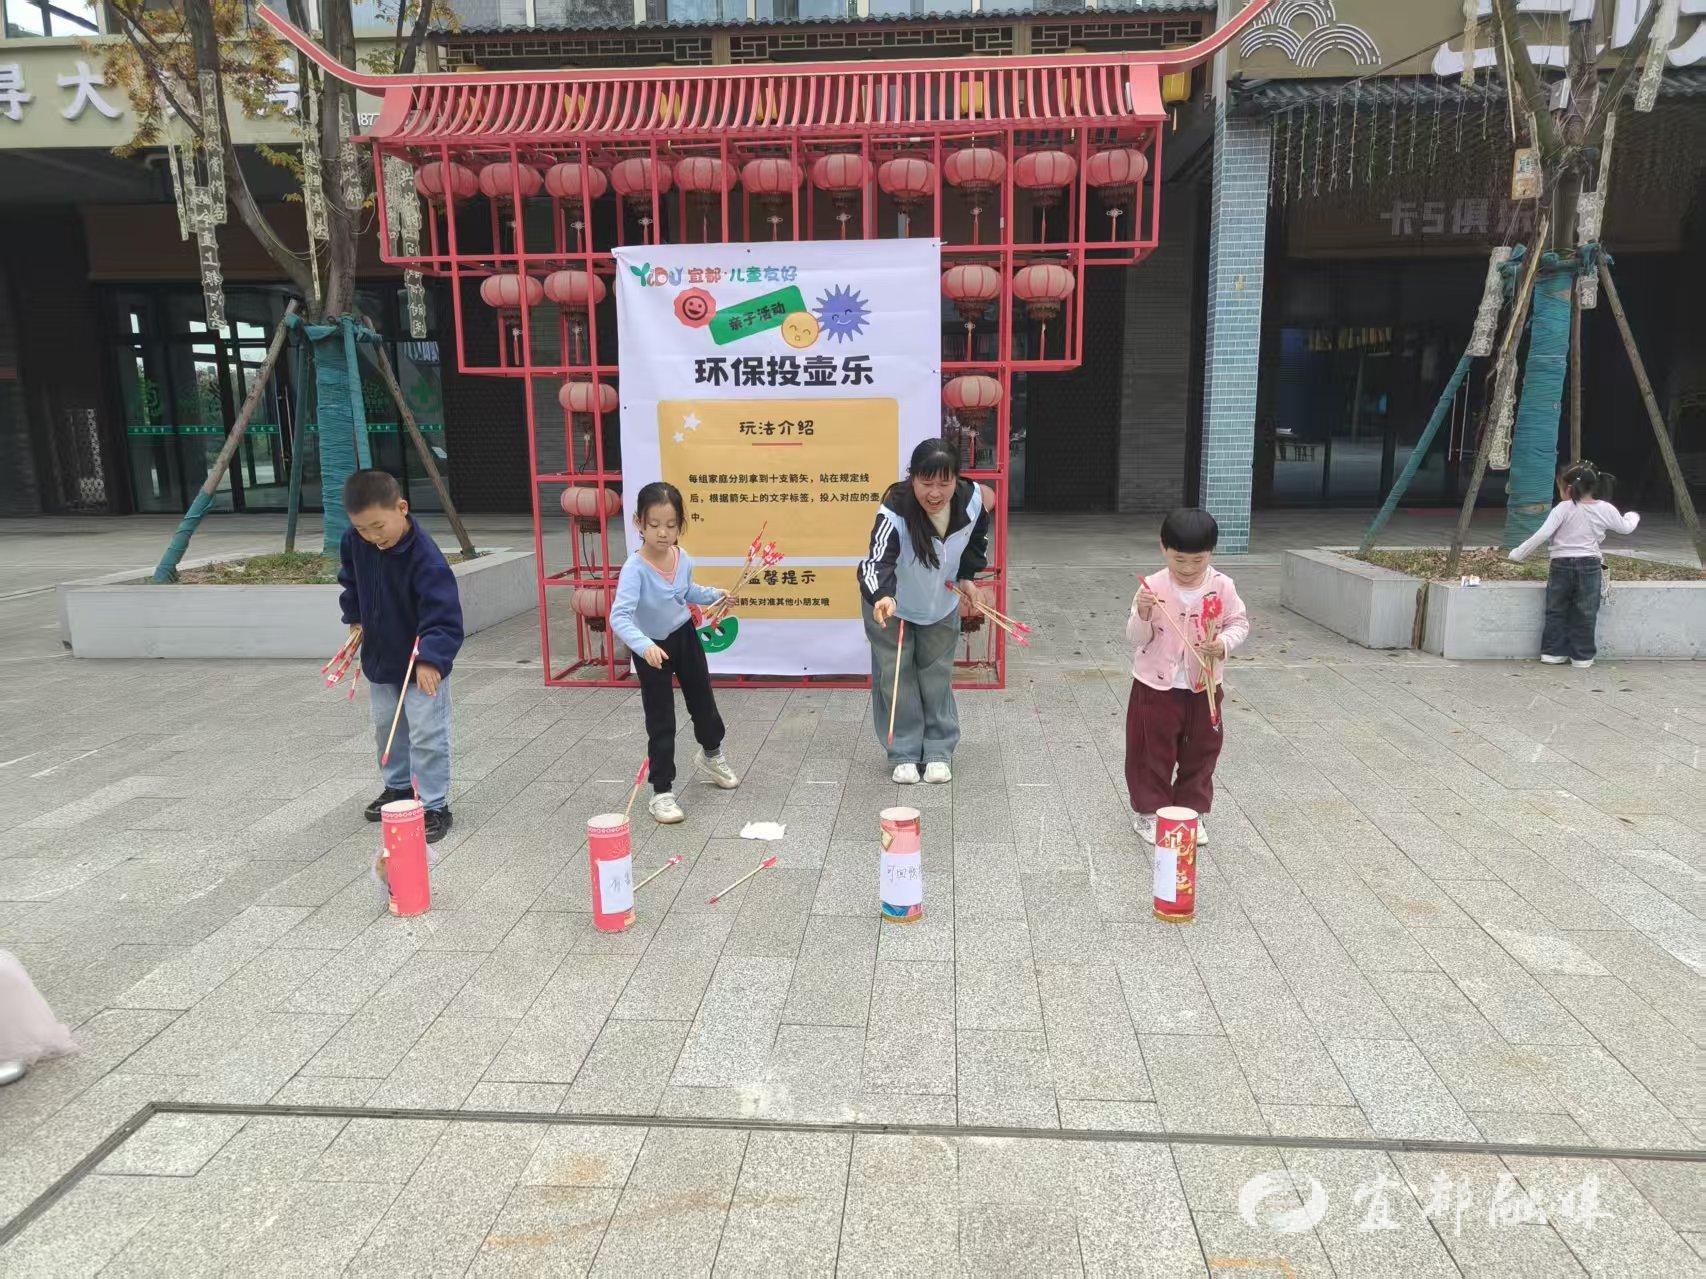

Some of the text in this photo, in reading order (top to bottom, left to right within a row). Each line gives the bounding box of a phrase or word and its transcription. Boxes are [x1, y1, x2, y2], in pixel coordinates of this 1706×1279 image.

[728, 302, 786, 331] 亲子活动
[694, 355, 874, 387] 环保投壶乐
[739, 419, 814, 437] 玩法介绍
